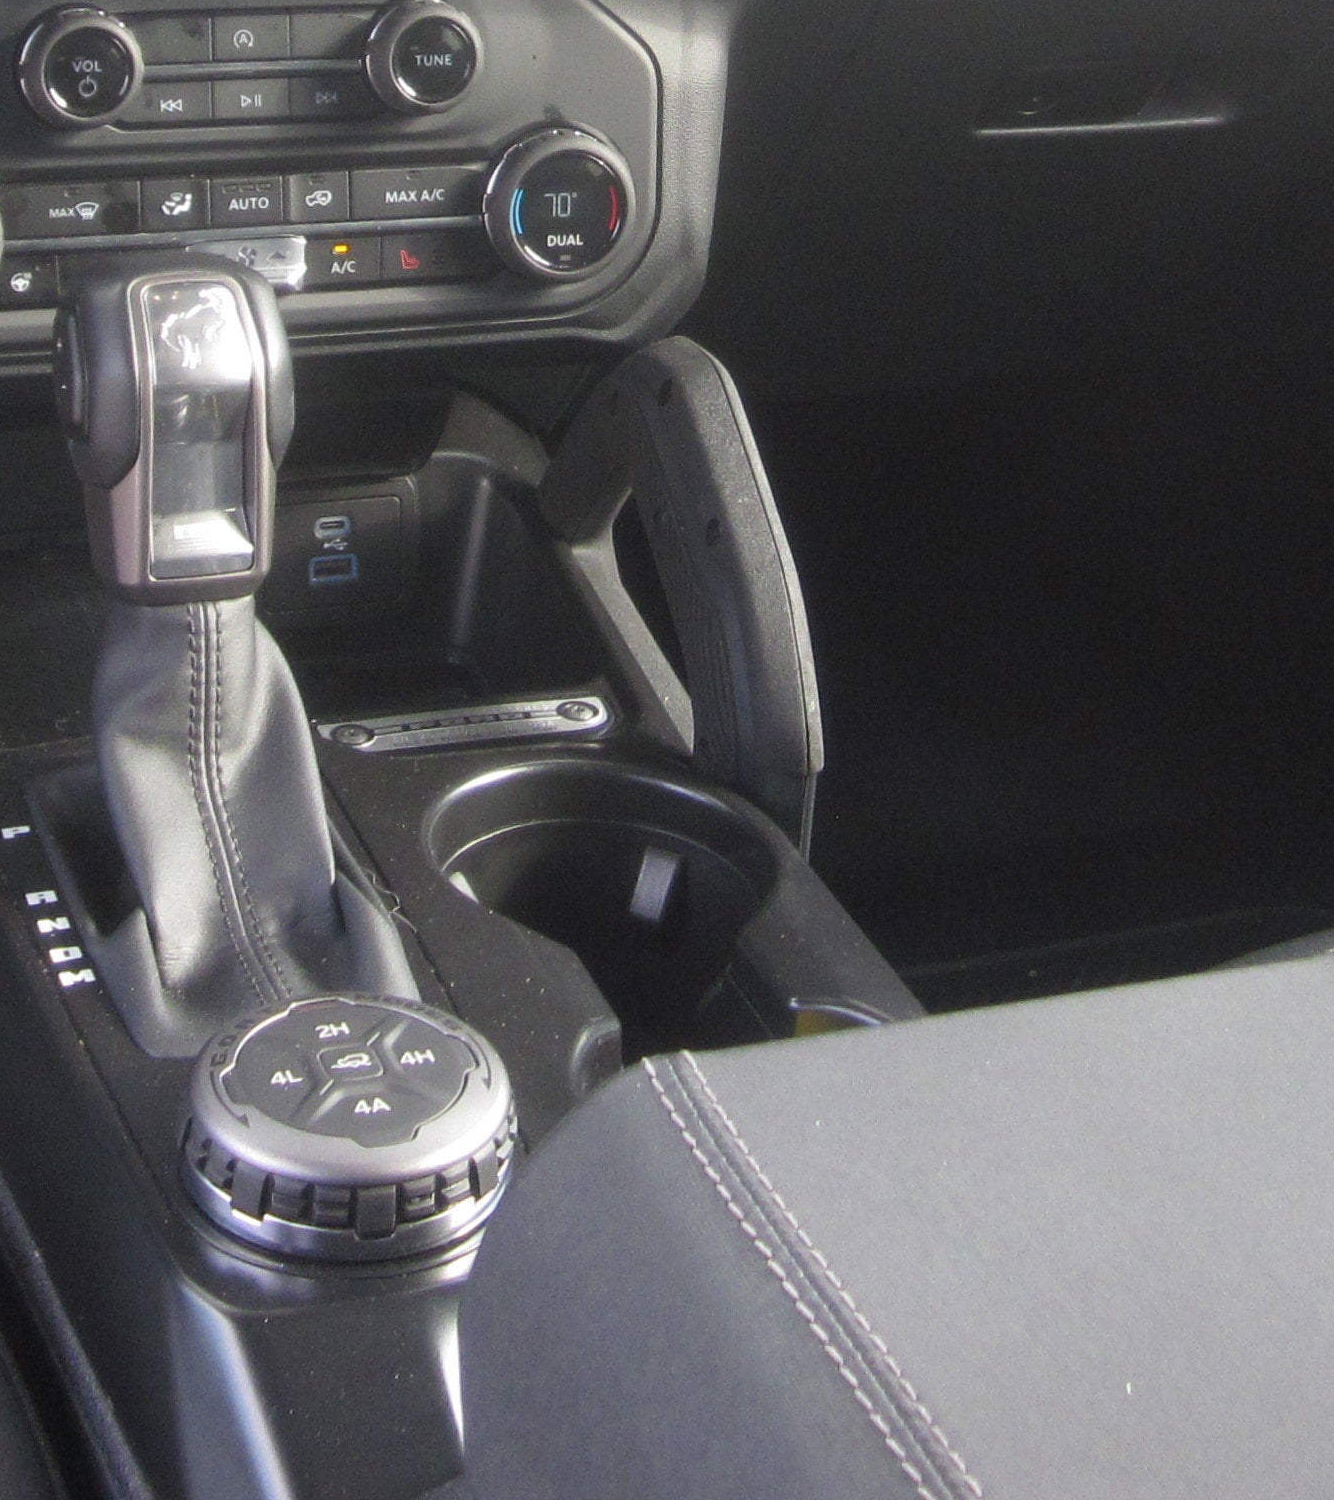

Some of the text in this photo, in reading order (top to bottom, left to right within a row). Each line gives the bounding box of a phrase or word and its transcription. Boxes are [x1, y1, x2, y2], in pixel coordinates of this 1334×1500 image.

[72, 60, 102, 73] VOL
[415, 54, 452, 66] TUNE
[385, 188, 445, 203] MAX A/C
[228, 197, 269, 211] AUTO
[49, 207, 76, 219] MAX
[547, 234, 583, 247] DUAL
[331, 260, 356, 274] A/C
[1, 825, 31, 839] P
[36, 916, 71, 933] N
[58, 968, 96, 987] M
[315, 1022, 350, 1039] 2H
[400, 1049, 435, 1065] 4H
[270, 1069, 304, 1086] 4L
[353, 1096, 391, 1114] 4A
